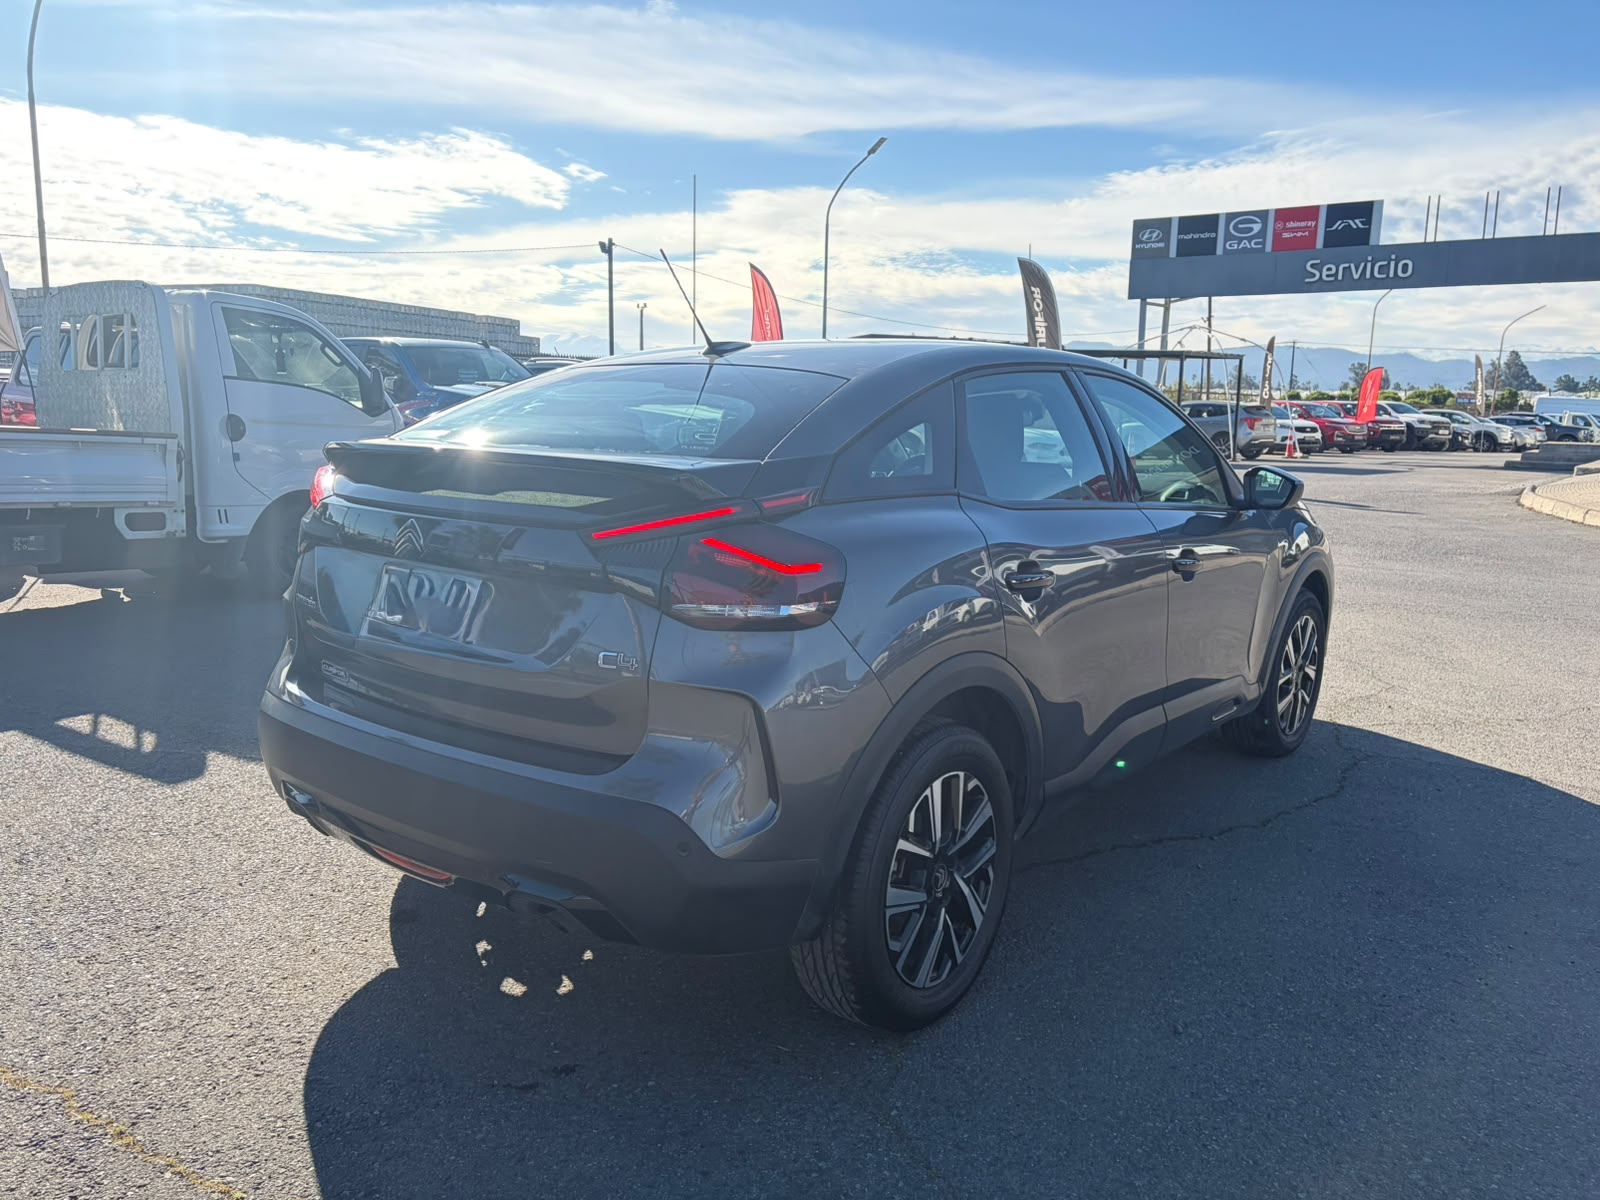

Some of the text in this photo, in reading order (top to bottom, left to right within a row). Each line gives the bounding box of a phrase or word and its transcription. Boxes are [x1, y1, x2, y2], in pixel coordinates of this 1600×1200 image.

[1178, 231, 1216, 240] mahindra
[1135, 241, 1166, 249] HYUNDAI
[1225, 238, 1263, 250] GAC
[1304, 254, 1413, 283] Servicio
[598, 651, 638, 671] C4
